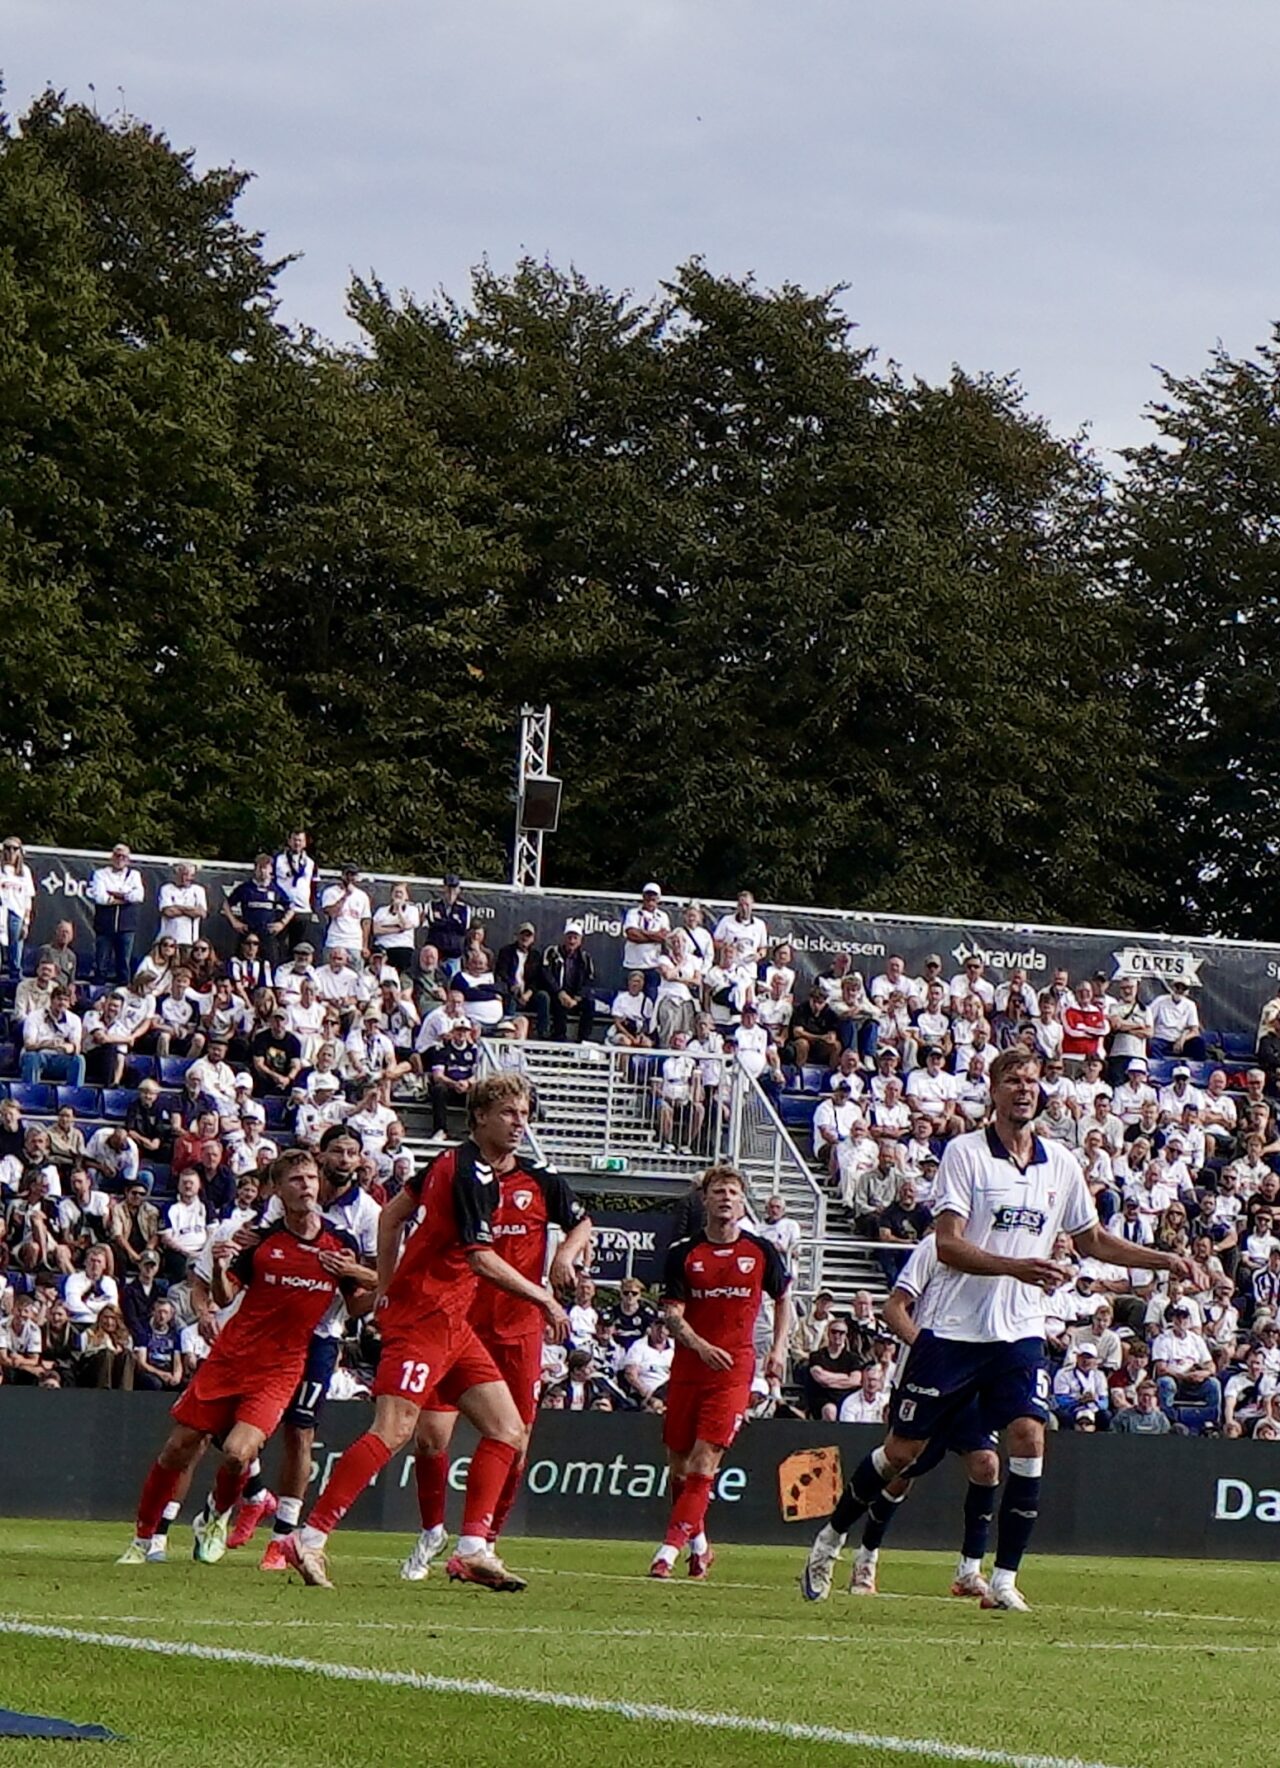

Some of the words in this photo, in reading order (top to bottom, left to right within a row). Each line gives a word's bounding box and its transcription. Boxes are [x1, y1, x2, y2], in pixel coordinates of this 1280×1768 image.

[764, 932, 885, 957] ndelskassen
[973, 943, 1047, 970] bravida
[1132, 956, 1185, 974] CERES
[601, 1231, 655, 1251] PARK
[401, 1359, 431, 1393] 13
[1035, 1368, 1050, 1399] 5
[299, 1380, 323, 1408] 17
[527, 1453, 748, 1502] omtae
